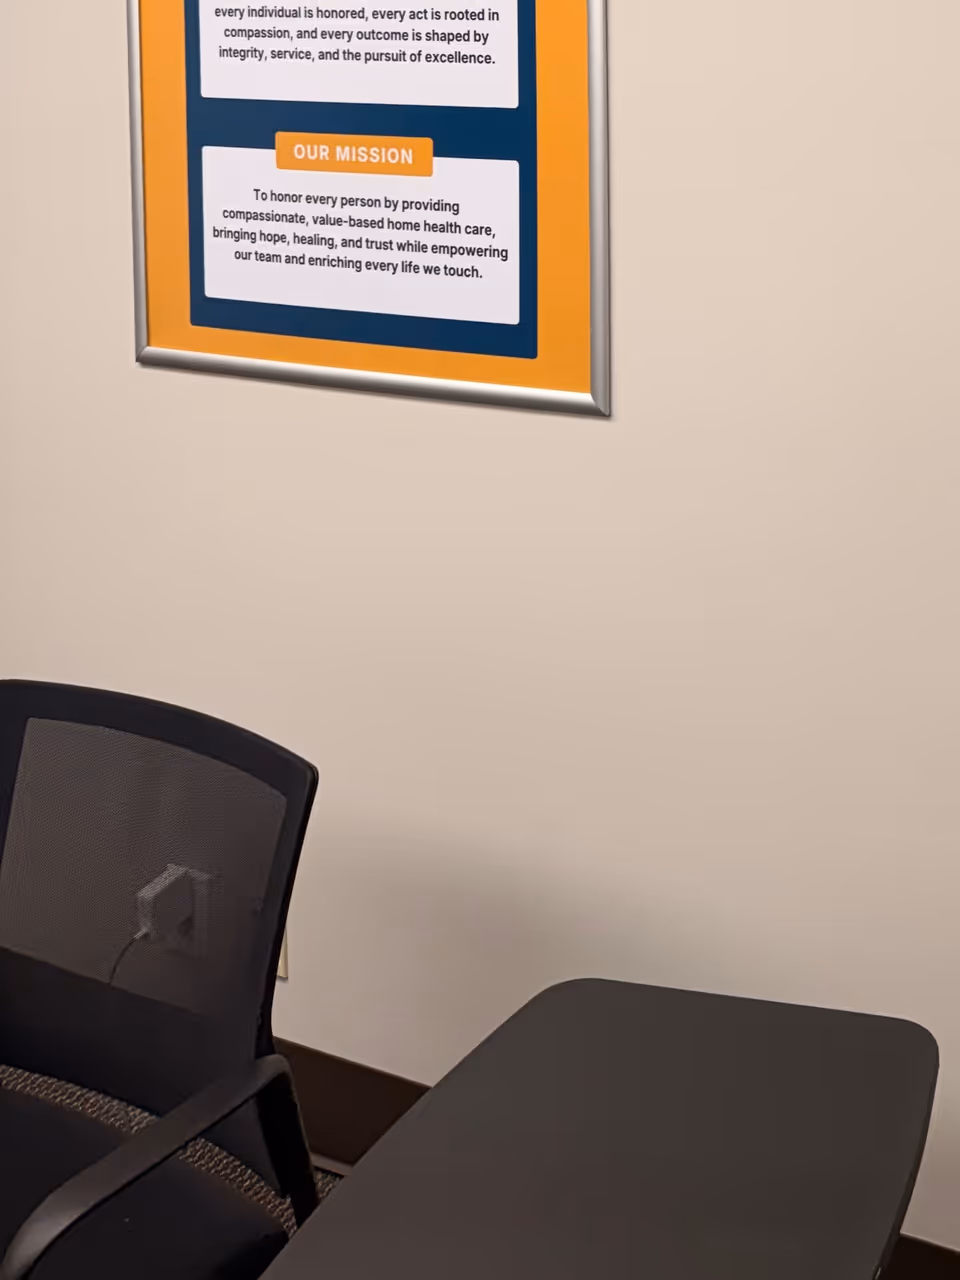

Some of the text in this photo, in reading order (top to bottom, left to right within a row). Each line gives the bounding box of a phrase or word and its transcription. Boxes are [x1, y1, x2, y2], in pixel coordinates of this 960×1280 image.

[214, 5, 499, 23] every individual is honored, every act is rooted in
[223, 26, 489, 46] compassion, and every outcome is shaped by
[218, 45, 495, 64] integrity, service, and the pursuit of excellence.
[293, 144, 412, 164] OUR MISSION
[252, 188, 460, 215] To honor every person by providing
[222, 209, 496, 239] compassionate, value-based home health care,
[212, 226, 508, 261] bringing hope, healing, and trust while empowering
[234, 250, 482, 278] our team and enriching every life we touch.
